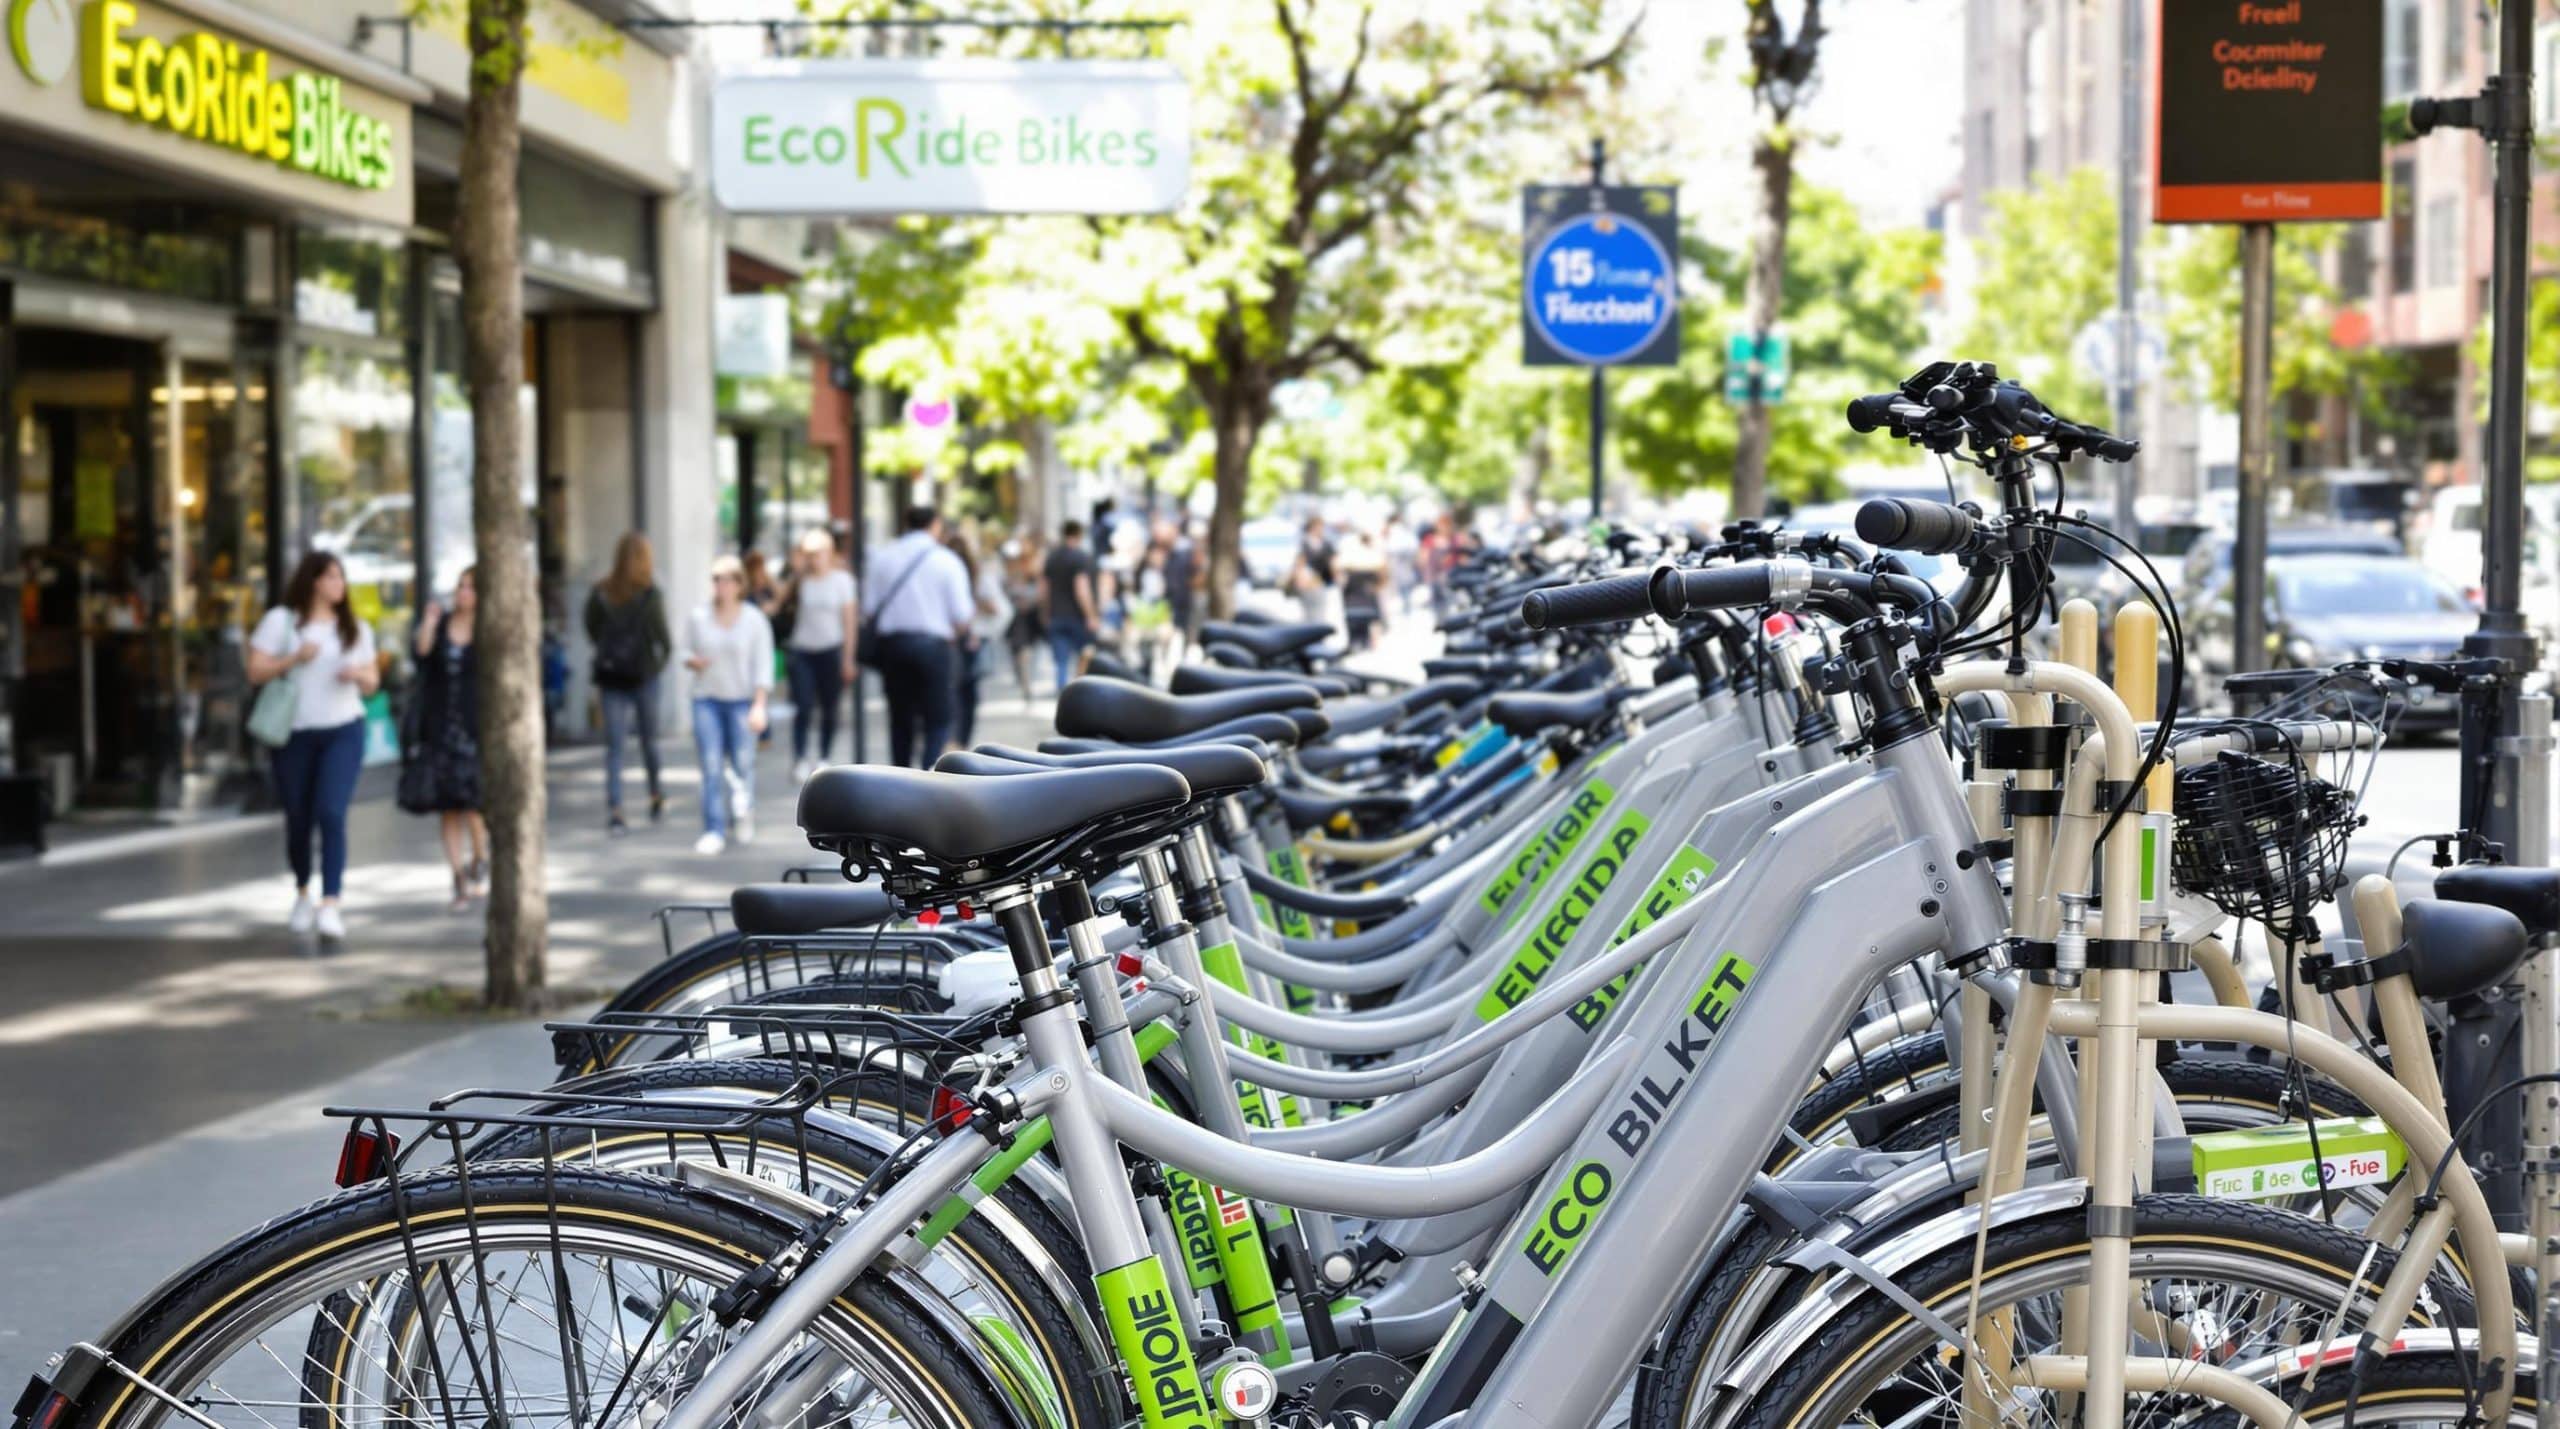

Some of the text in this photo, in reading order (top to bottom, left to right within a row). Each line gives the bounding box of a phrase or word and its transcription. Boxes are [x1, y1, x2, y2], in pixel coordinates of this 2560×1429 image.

[1018, 113, 1158, 167] Bikes
[1549, 248, 1594, 287] 15
[1523, 1162, 1612, 1277] ECO
